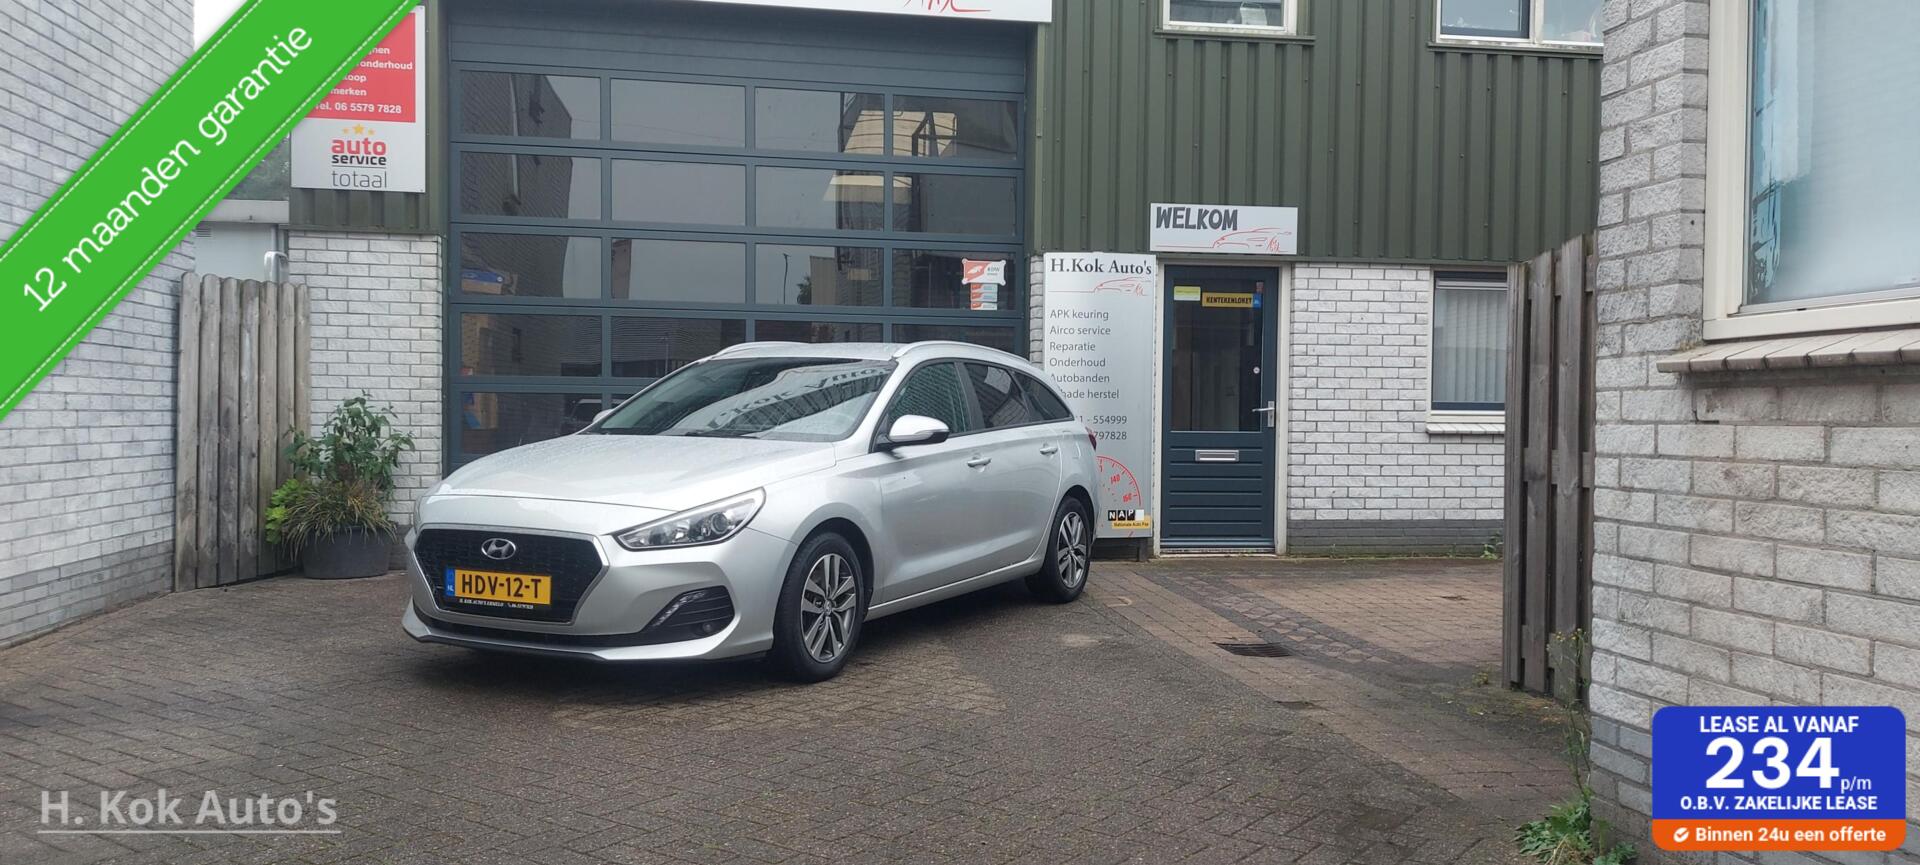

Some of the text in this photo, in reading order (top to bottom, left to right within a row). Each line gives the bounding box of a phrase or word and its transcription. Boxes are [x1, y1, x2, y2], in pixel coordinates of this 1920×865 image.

[357, 60, 413, 70] onderhoud
[335, 102, 347, 111] 06
[350, 103, 375, 112] 5579
[377, 104, 402, 114] 7828
[331, 137, 387, 155] auto
[331, 154, 387, 165] service
[331, 170, 387, 188] totaal
[1156, 206, 1238, 231] WELKOM
[1051, 258, 1152, 275] H.Kok Auto's
[1050, 309, 1109, 321] APK keuring
[1049, 325, 1111, 335] Airco service
[1049, 341, 1096, 352] Reparatie
[1049, 357, 1106, 367] Onderhoud
[1087, 388, 1120, 399] herstel
[1093, 415, 1128, 425] 554999
[1093, 431, 1127, 440] 797828
[462, 574, 541, 599] HDV-12-T
